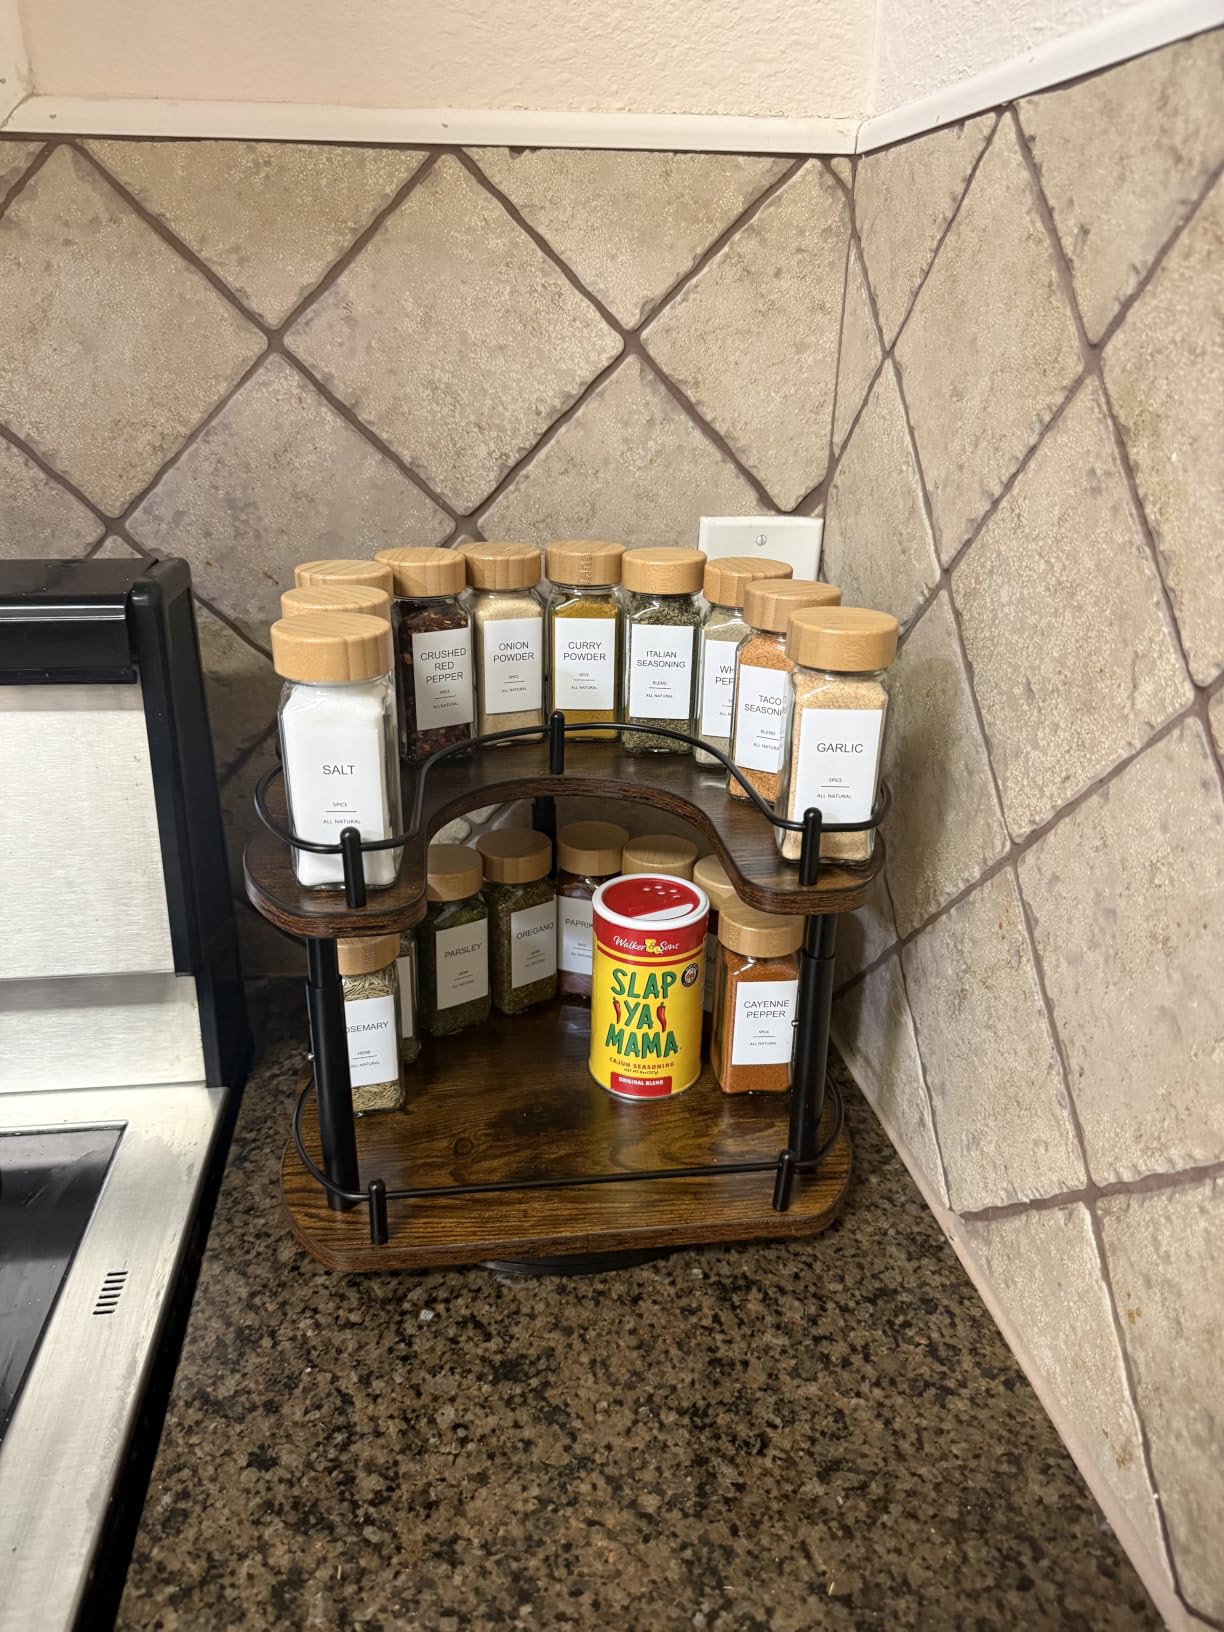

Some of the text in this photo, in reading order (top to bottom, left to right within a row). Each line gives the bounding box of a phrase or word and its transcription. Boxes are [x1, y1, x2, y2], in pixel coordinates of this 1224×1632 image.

[498, 641, 529, 652] ONION
[568, 641, 602, 650] CURRY
[420, 647, 467, 661] CRUSHED
[493, 652, 535, 663] POWDER
[563, 652, 606, 661] POWDER
[646, 650, 677, 659] ITALIAN
[434, 661, 455, 672] RED
[636, 659, 686, 669] SEASONING
[425, 672, 464, 685] PEPPER
[715, 676, 735, 686] PEP
[758, 694, 782, 706] TACO
[744, 703, 782, 716] SEASONI
[761, 743, 780, 751] NATURA
[816, 742, 864, 754] GARLIC
[322, 764, 356, 776] SALT
[565, 917, 593, 929] PAPRI
[515, 922, 554, 940] OREGANO
[613, 935, 647, 951] Walker
[657, 940, 680, 953] Sons
[444, 942, 482, 959] PARSLEY
[610, 967, 677, 1000] SLAP
[743, 999, 790, 1009] CAYENNE
[623, 999, 654, 1030] YA
[746, 1010, 786, 1019] PEPPER
[345, 1021, 389, 1033] OSEMARY
[605, 1023, 679, 1059] MAMA
[609, 1056, 675, 1070] CAJUN SEASONING
[618, 1076, 645, 1086] ORIGINAL
